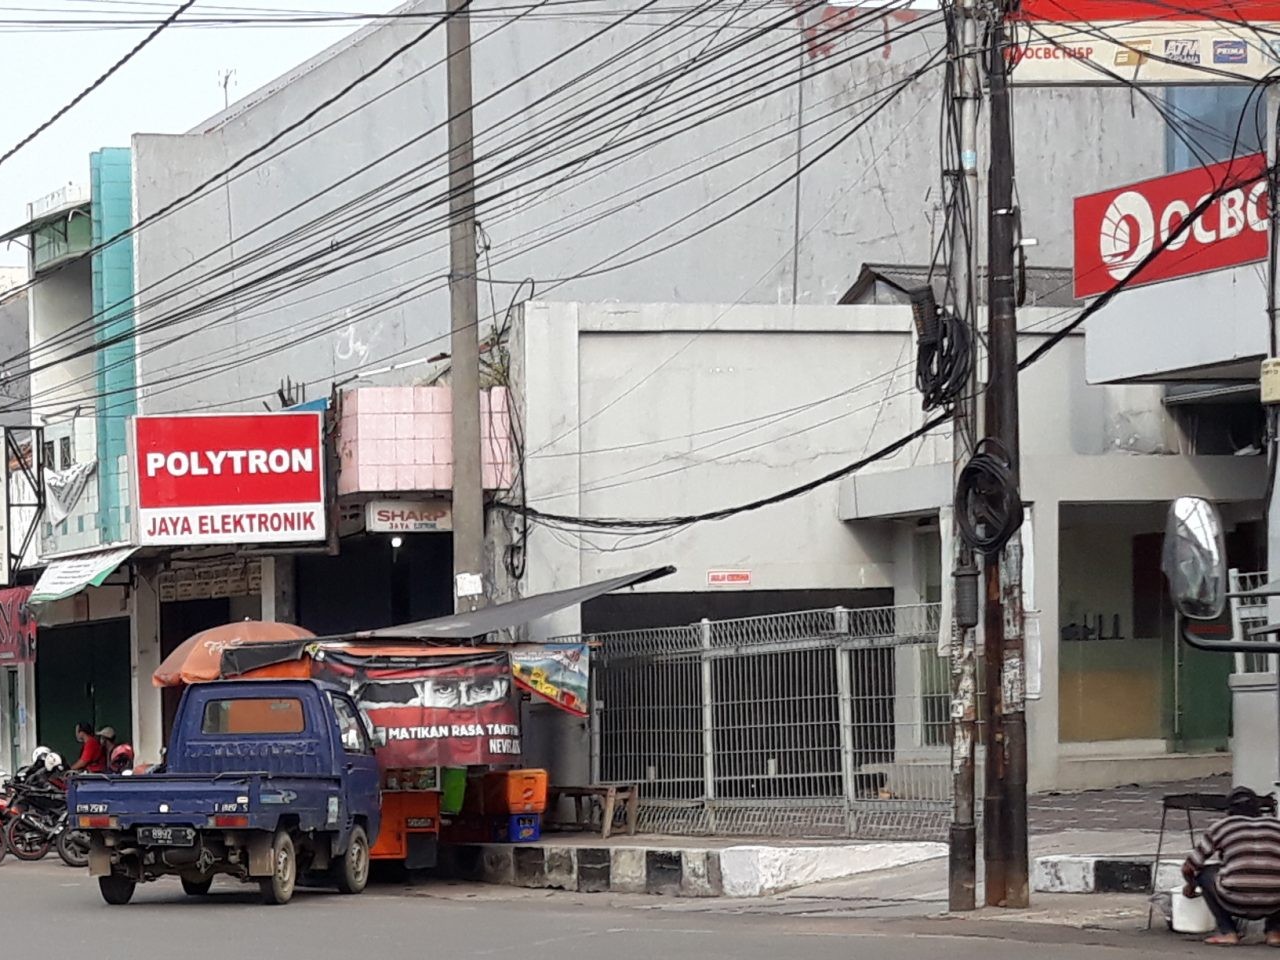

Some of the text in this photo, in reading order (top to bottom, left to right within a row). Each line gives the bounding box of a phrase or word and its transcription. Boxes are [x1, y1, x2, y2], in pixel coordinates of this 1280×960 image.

[146, 448, 313, 478] POLYTRON
[147, 511, 317, 537] JAYA ELEKTRONIK
[377, 509, 448, 522] SHARP
[388, 725, 449, 740] MATIKAN
[451, 724, 485, 738] RASA
